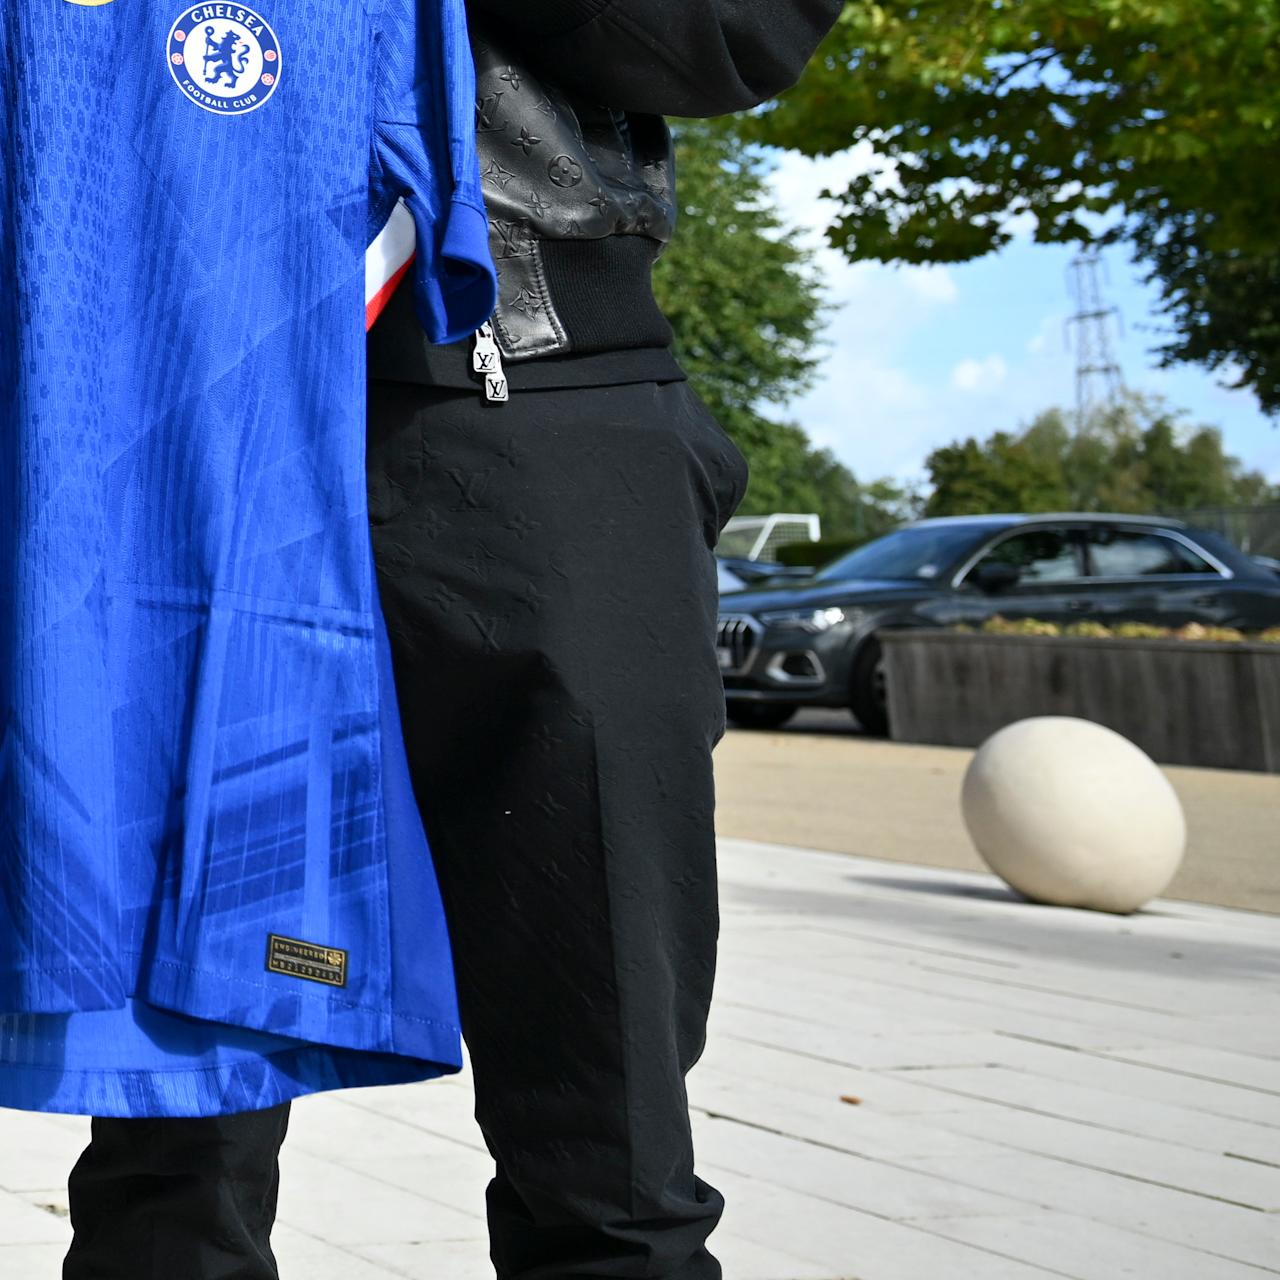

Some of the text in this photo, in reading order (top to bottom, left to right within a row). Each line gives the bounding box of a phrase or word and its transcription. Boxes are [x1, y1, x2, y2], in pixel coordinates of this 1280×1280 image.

[191, 5, 265, 38] CHELSEA
[182, 80, 258, 109] FOOTBALL CLUB
